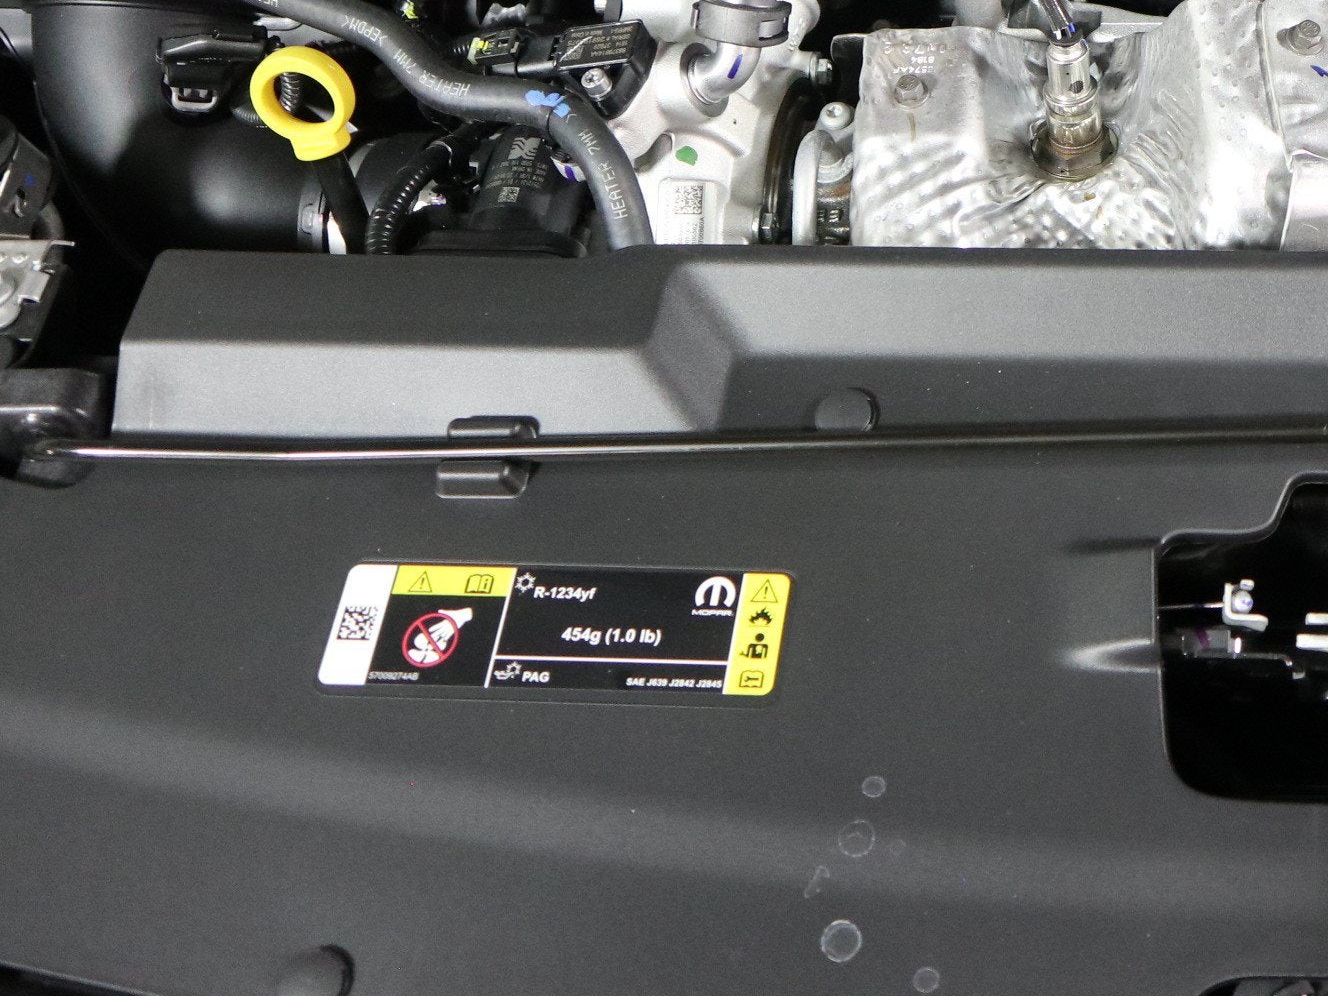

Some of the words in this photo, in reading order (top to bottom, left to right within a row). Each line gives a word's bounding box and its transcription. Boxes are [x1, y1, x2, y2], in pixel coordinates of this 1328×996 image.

[419, 70, 470, 96] HEATER
[597, 160, 628, 220] HEATER
[533, 586, 597, 603] R-1234yf
[691, 609, 733, 617] MOPAR
[561, 627, 601, 645] 454g
[605, 628, 636, 645] (1.0
[639, 629, 662, 646] lb)
[522, 671, 550, 683] PAG
[626, 677, 646, 686] SAE
[646, 678, 668, 687] J639
